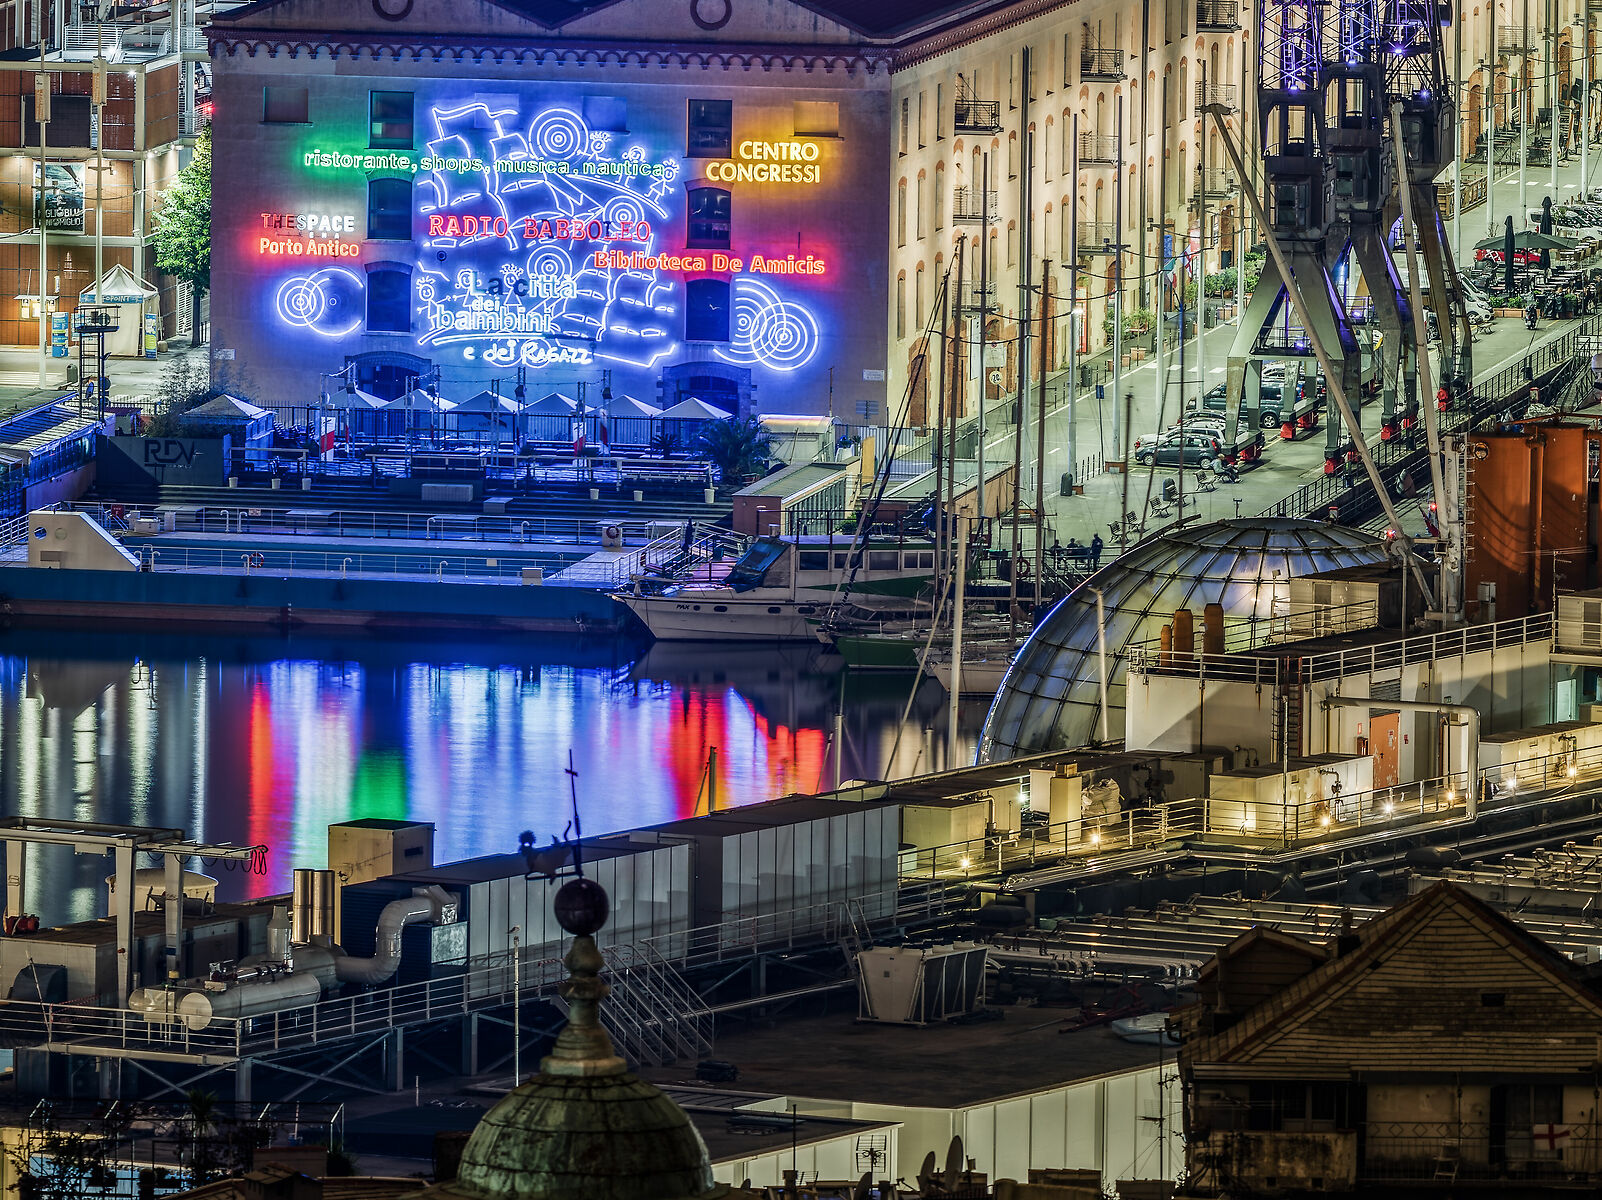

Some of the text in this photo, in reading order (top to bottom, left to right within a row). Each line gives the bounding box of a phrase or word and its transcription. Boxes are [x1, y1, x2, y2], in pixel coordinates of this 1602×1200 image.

[739, 140, 820, 162] CENTRO
[304, 149, 418, 173] ristorante,
[420, 154, 491, 174] shops,
[582, 159, 665, 177] nautica
[705, 161, 820, 184] CONGRESSI
[428, 214, 652, 243] RADIO BABBOLEO
[260, 237, 359, 257] Porto Antico
[593, 251, 826, 275] Biblioteca De Amicis
[470, 296, 502, 313] dei
[436, 303, 552, 333] bambini
[463, 346, 476, 360] e
[482, 340, 517, 362] dei
